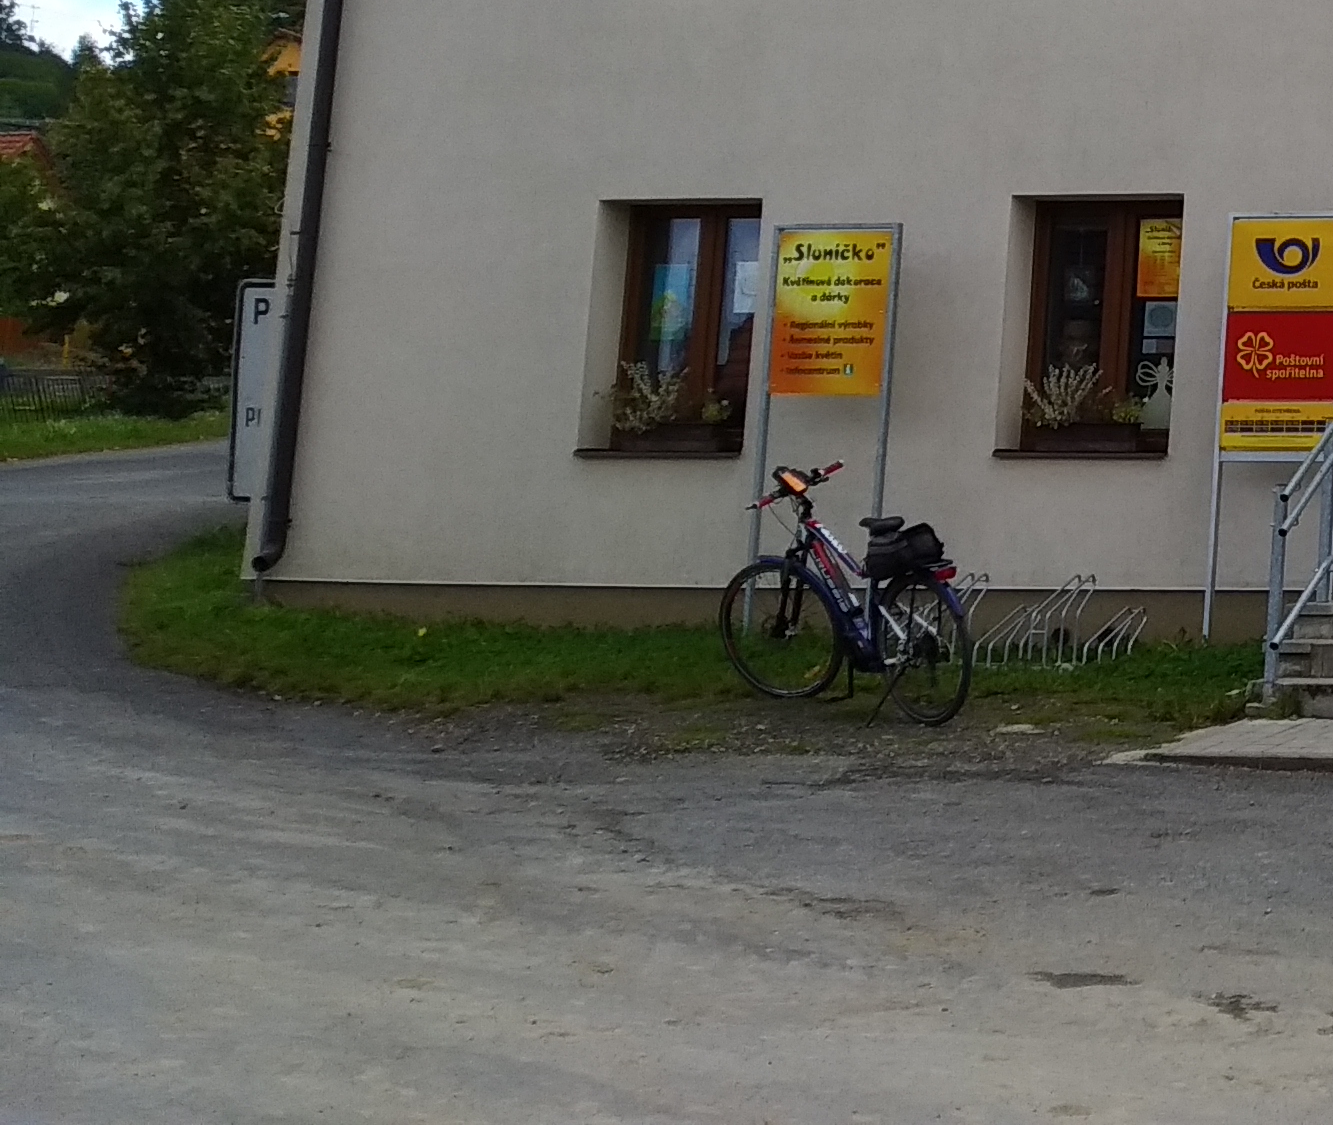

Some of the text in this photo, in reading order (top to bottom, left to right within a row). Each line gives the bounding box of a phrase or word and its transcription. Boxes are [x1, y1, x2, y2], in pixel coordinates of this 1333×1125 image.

[834, 276, 882, 287] dekorace
[1252, 277, 1319, 292] Česká pošta
[811, 291, 850, 305] a dárky
[1275, 354, 1324, 366] Poštovní
[1265, 367, 1324, 381] spořitelna
